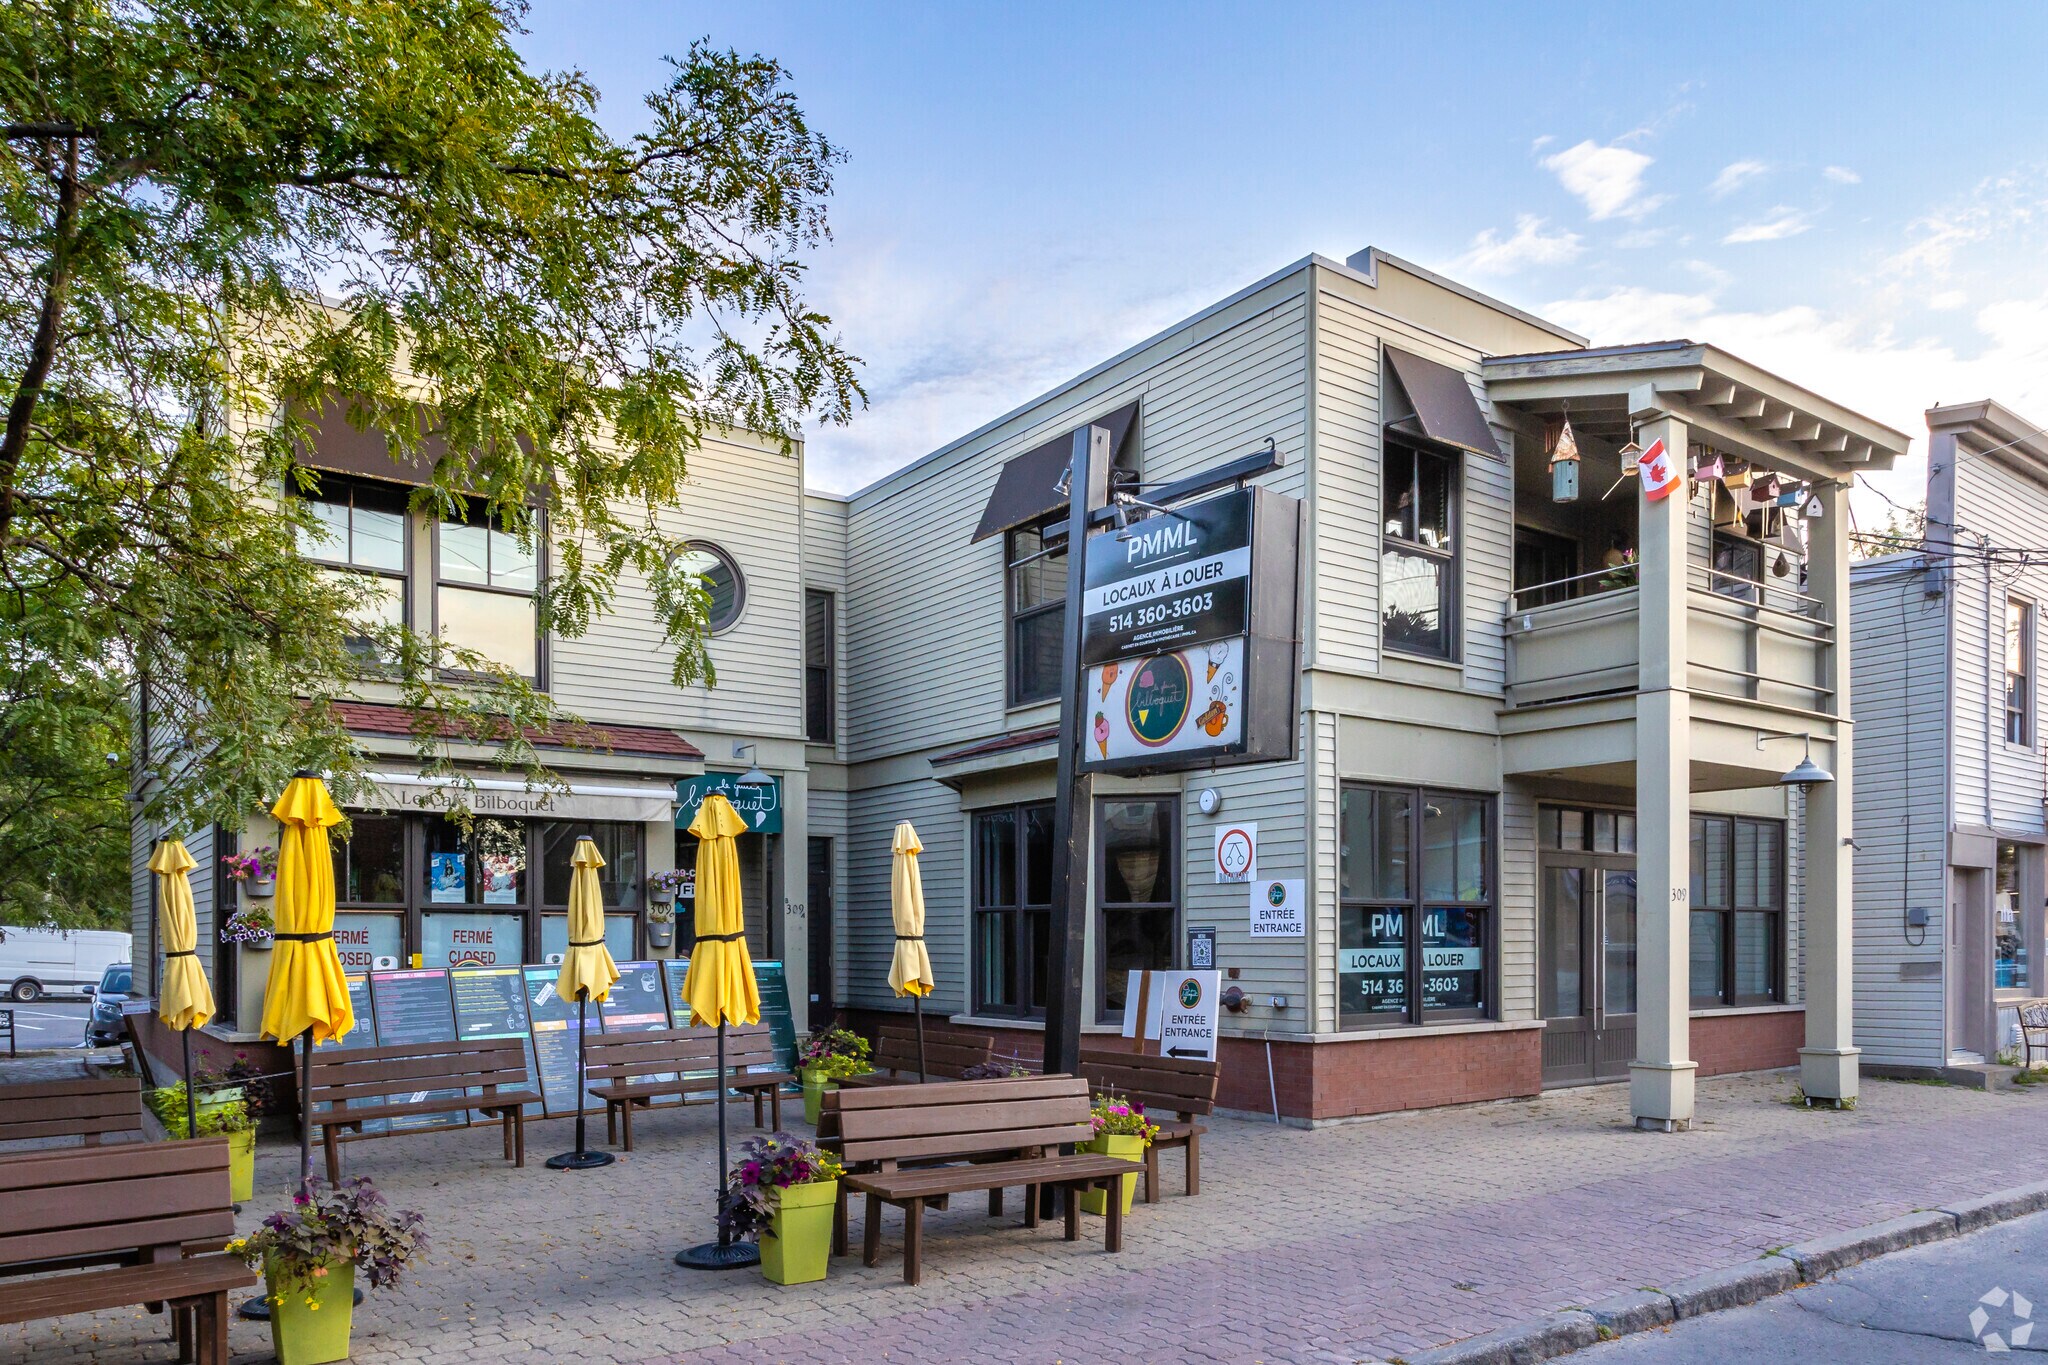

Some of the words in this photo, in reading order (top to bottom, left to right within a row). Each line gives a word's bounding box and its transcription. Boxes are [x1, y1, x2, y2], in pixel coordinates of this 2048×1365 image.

[1127, 520, 1197, 563] PMML
[1103, 579, 1156, 606] LOCAUX
[1161, 571, 1171, 592] À
[1175, 561, 1224, 588] LOUER
[1109, 612, 1133, 633] 514
[1137, 592, 1213, 626] 360-3603
[402, 790, 421, 805] Le
[474, 794, 555, 813] Bilboquet
[1672, 888, 1686, 902] 309
[1260, 908, 1295, 920] ENTRÉE
[333, 926, 369, 945] ERMÉ
[453, 926, 493, 944] FERMÉ
[1253, 922, 1302, 933] ENTRANCE
[338, 951, 373, 966] OSED
[448, 950, 496, 965] CLOSED
[1351, 954, 1401, 969] LOCAUX
[1428, 953, 1464, 967] LOUER
[1361, 979, 1383, 995] 514
[1171, 1013, 1206, 1025] ENTRÉE
[1165, 1027, 1212, 1038] ENTRANCE
